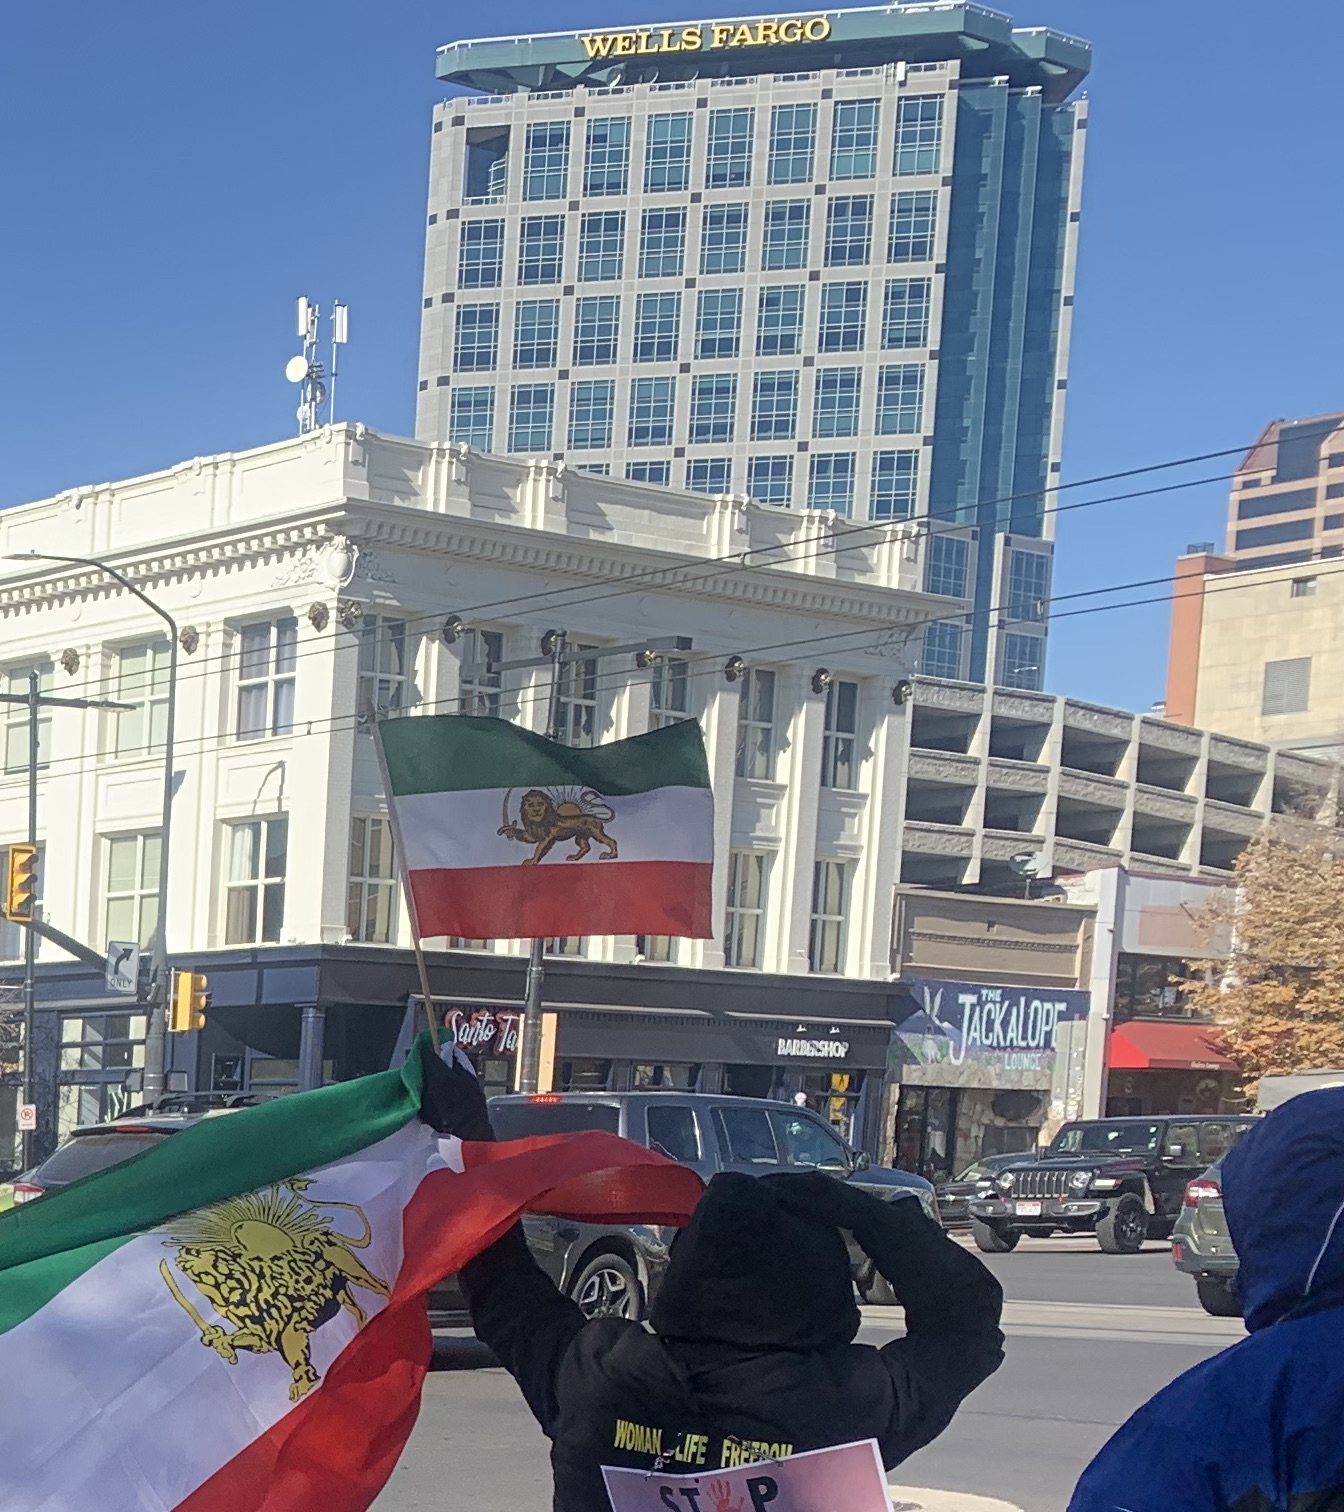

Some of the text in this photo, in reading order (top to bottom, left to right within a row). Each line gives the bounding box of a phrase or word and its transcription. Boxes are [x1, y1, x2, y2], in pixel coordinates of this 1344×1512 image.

[581, 17, 831, 59] WELLS FARGO
[109, 978, 133, 989] ONLY
[981, 988, 1002, 1001] THE
[450, 1010, 520, 1052] Santo Ta
[949, 994, 1067, 1065] JACKALOPE
[777, 1038, 849, 1058] BARBERSHOP
[1004, 1053, 1041, 1070] LOUNGE
[614, 1419, 662, 1456] WOMAN
[675, 1433, 709, 1465] LIFE
